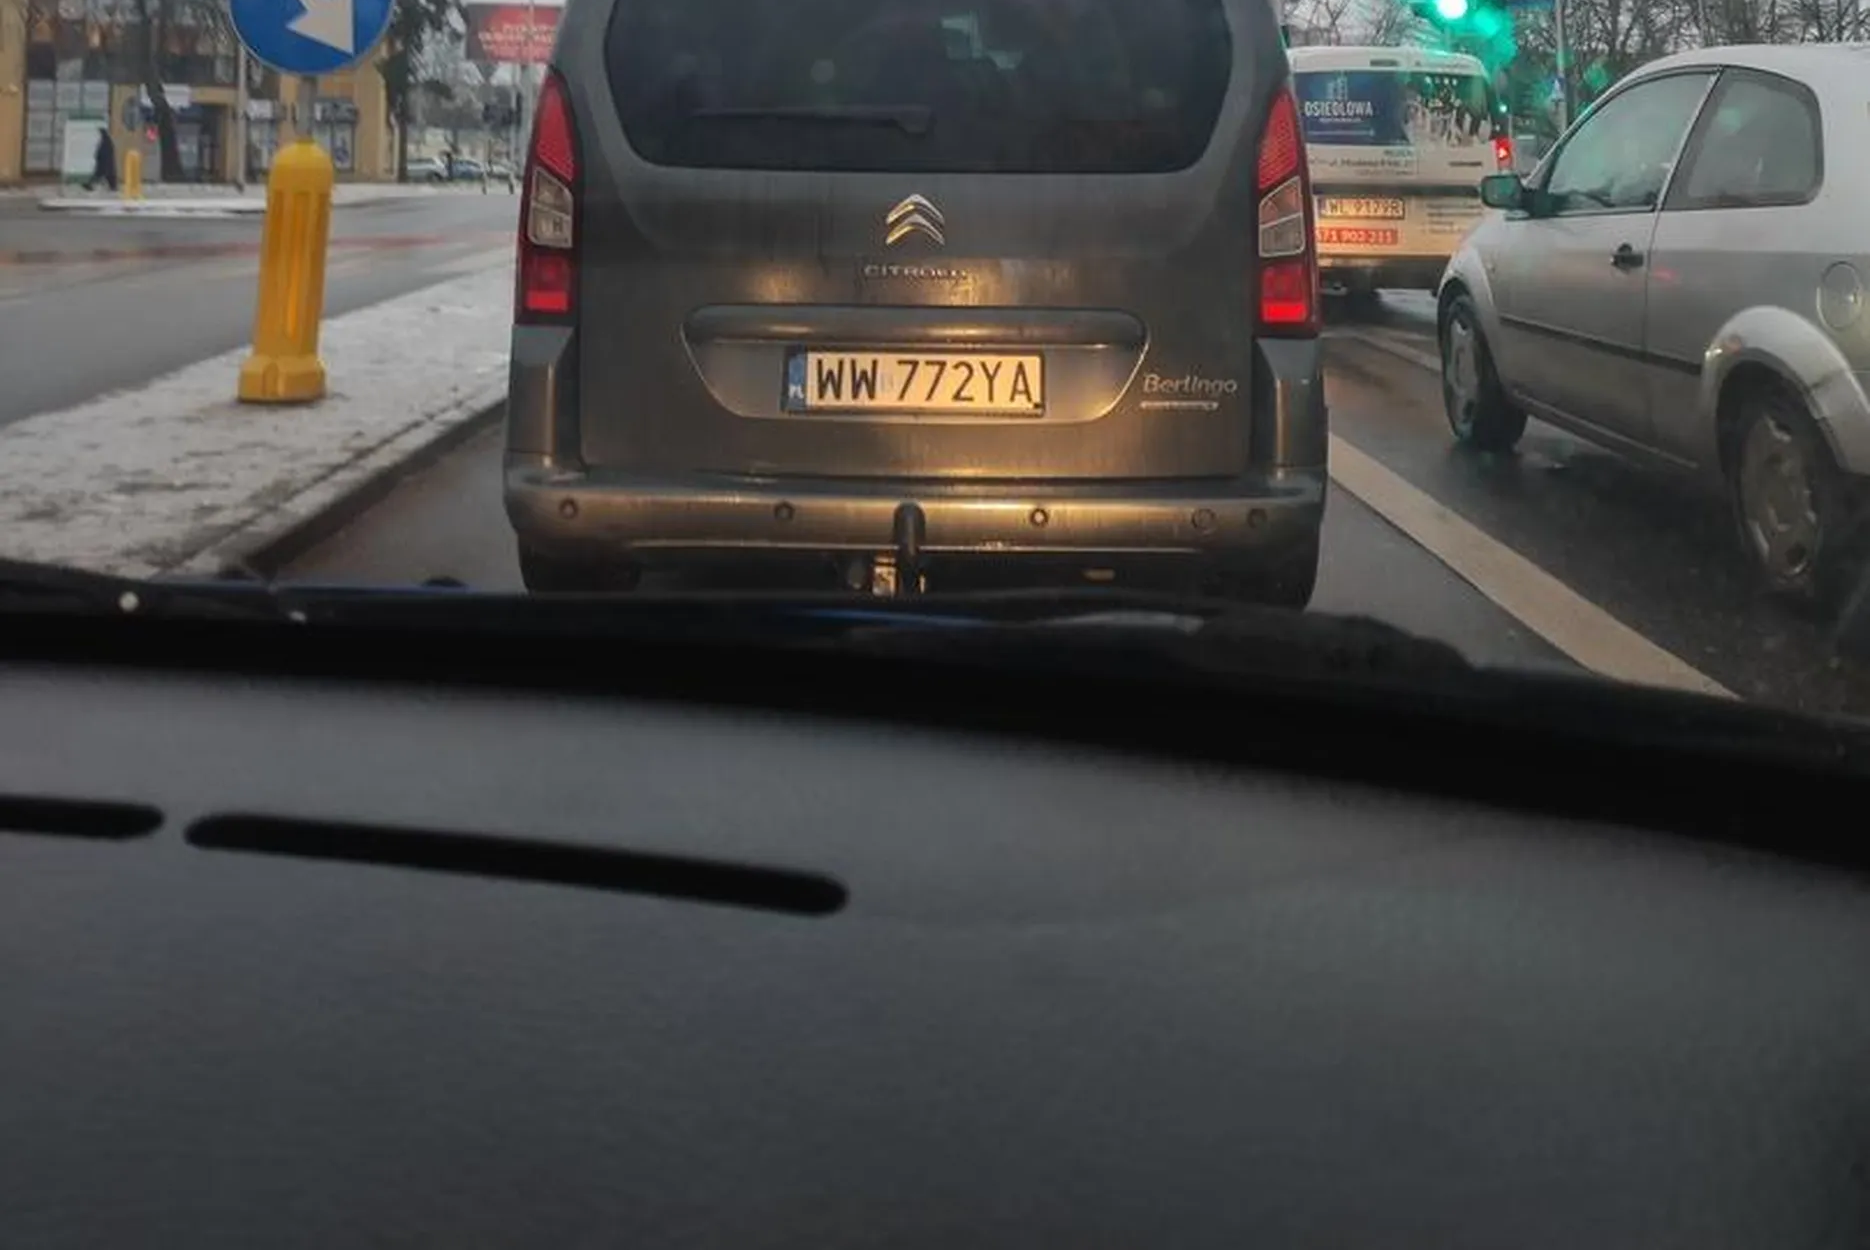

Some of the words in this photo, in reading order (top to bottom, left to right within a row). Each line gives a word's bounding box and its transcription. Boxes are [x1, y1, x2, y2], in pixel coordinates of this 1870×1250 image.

[816, 358, 878, 401] WW
[897, 359, 1034, 404] 772YA
[1143, 374, 1237, 396] Berlingo
